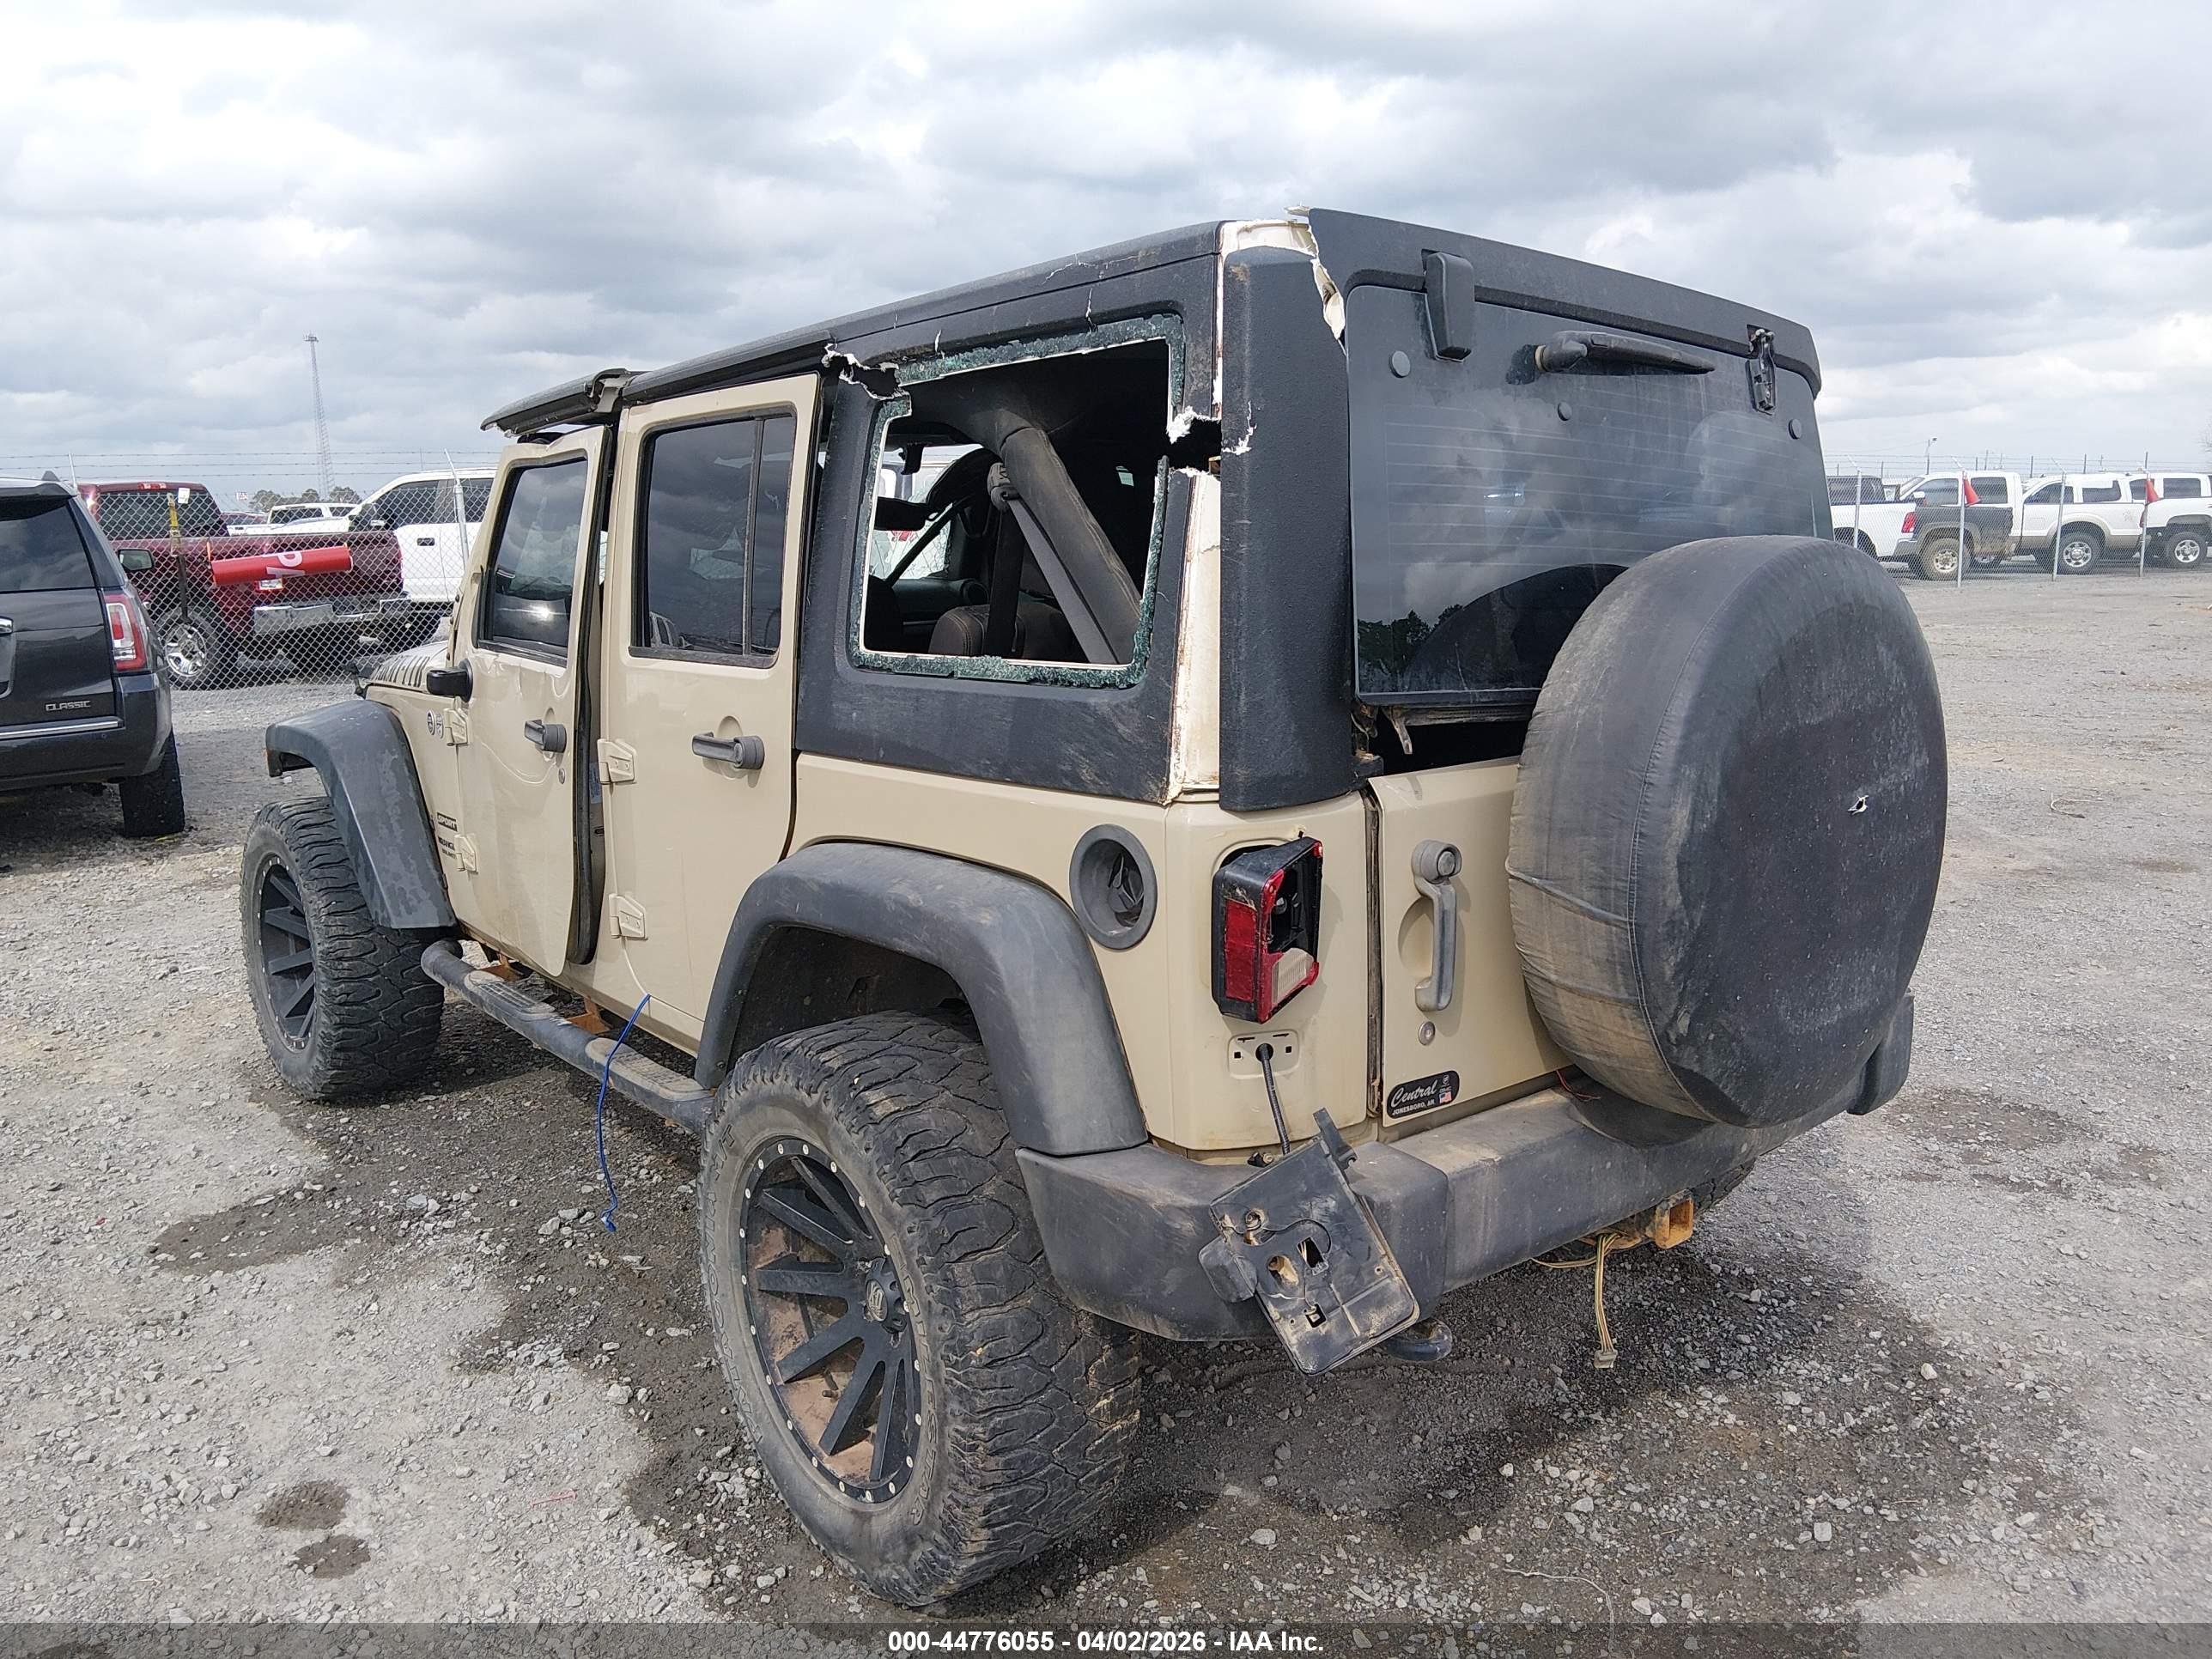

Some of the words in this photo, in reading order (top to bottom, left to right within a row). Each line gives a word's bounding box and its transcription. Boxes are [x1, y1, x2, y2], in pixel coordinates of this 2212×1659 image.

[46, 700, 91, 712] CLASSIC
[438, 815, 456, 830] SPORT
[1391, 1079, 1437, 1108] Central
[1392, 1102, 1426, 1115] JONESBORO,
[902, 1275, 938, 1526] MILESTAR
